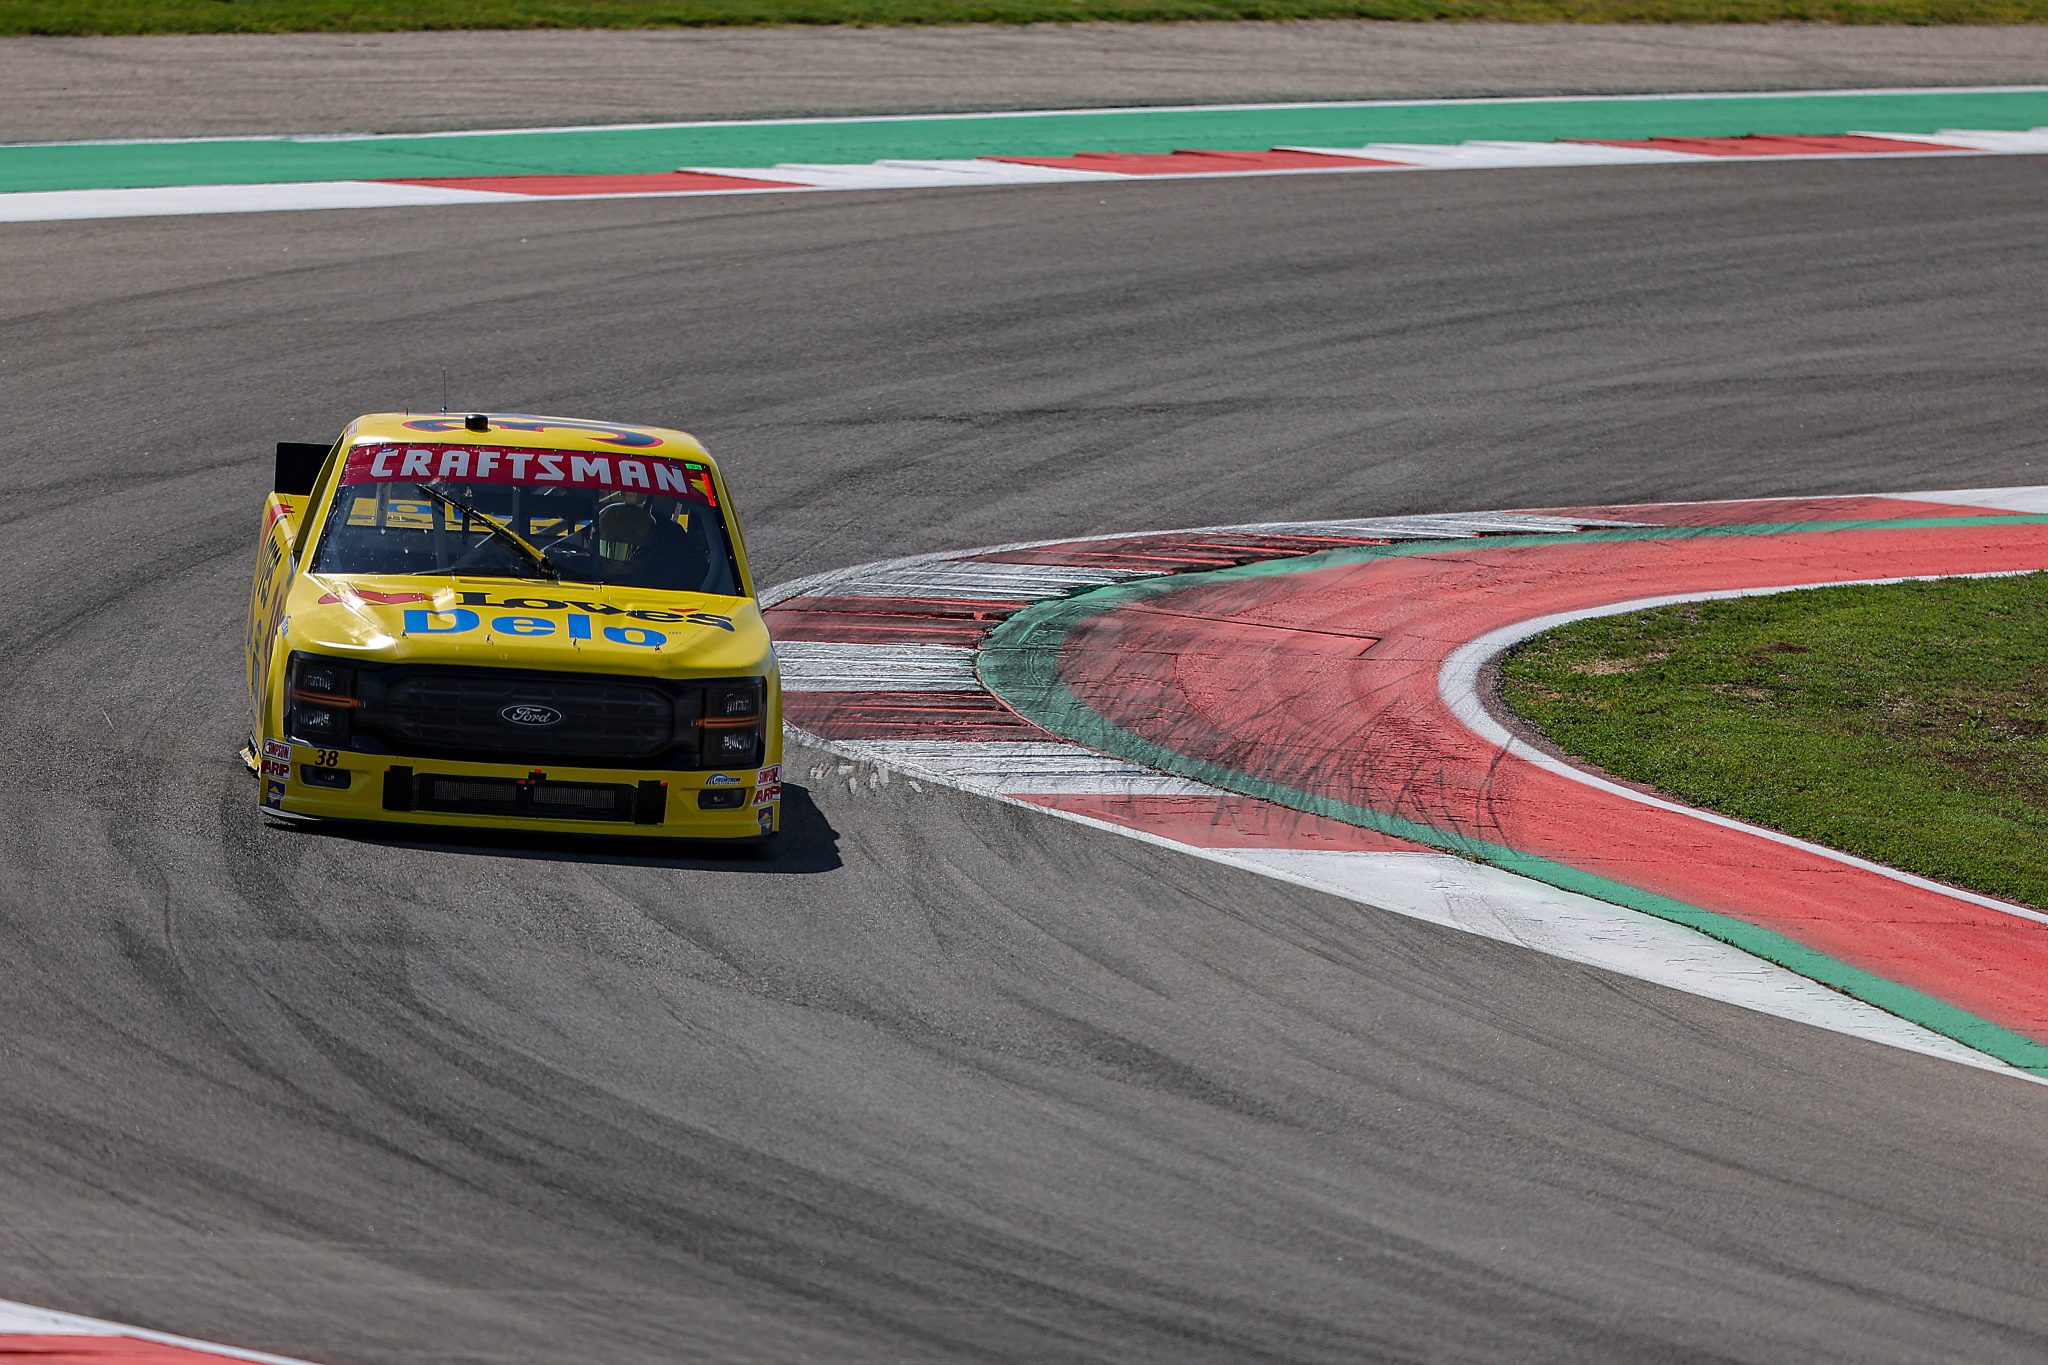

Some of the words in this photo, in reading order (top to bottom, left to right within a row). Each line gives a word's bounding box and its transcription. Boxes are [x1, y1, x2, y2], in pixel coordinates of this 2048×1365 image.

[370, 449, 687, 494] CRAFTSMAN
[403, 609, 668, 647] Delo
[512, 707, 551, 722] Ford
[315, 749, 339, 767] 38
[261, 760, 290, 777] ARP
[753, 786, 781, 804] ARP
